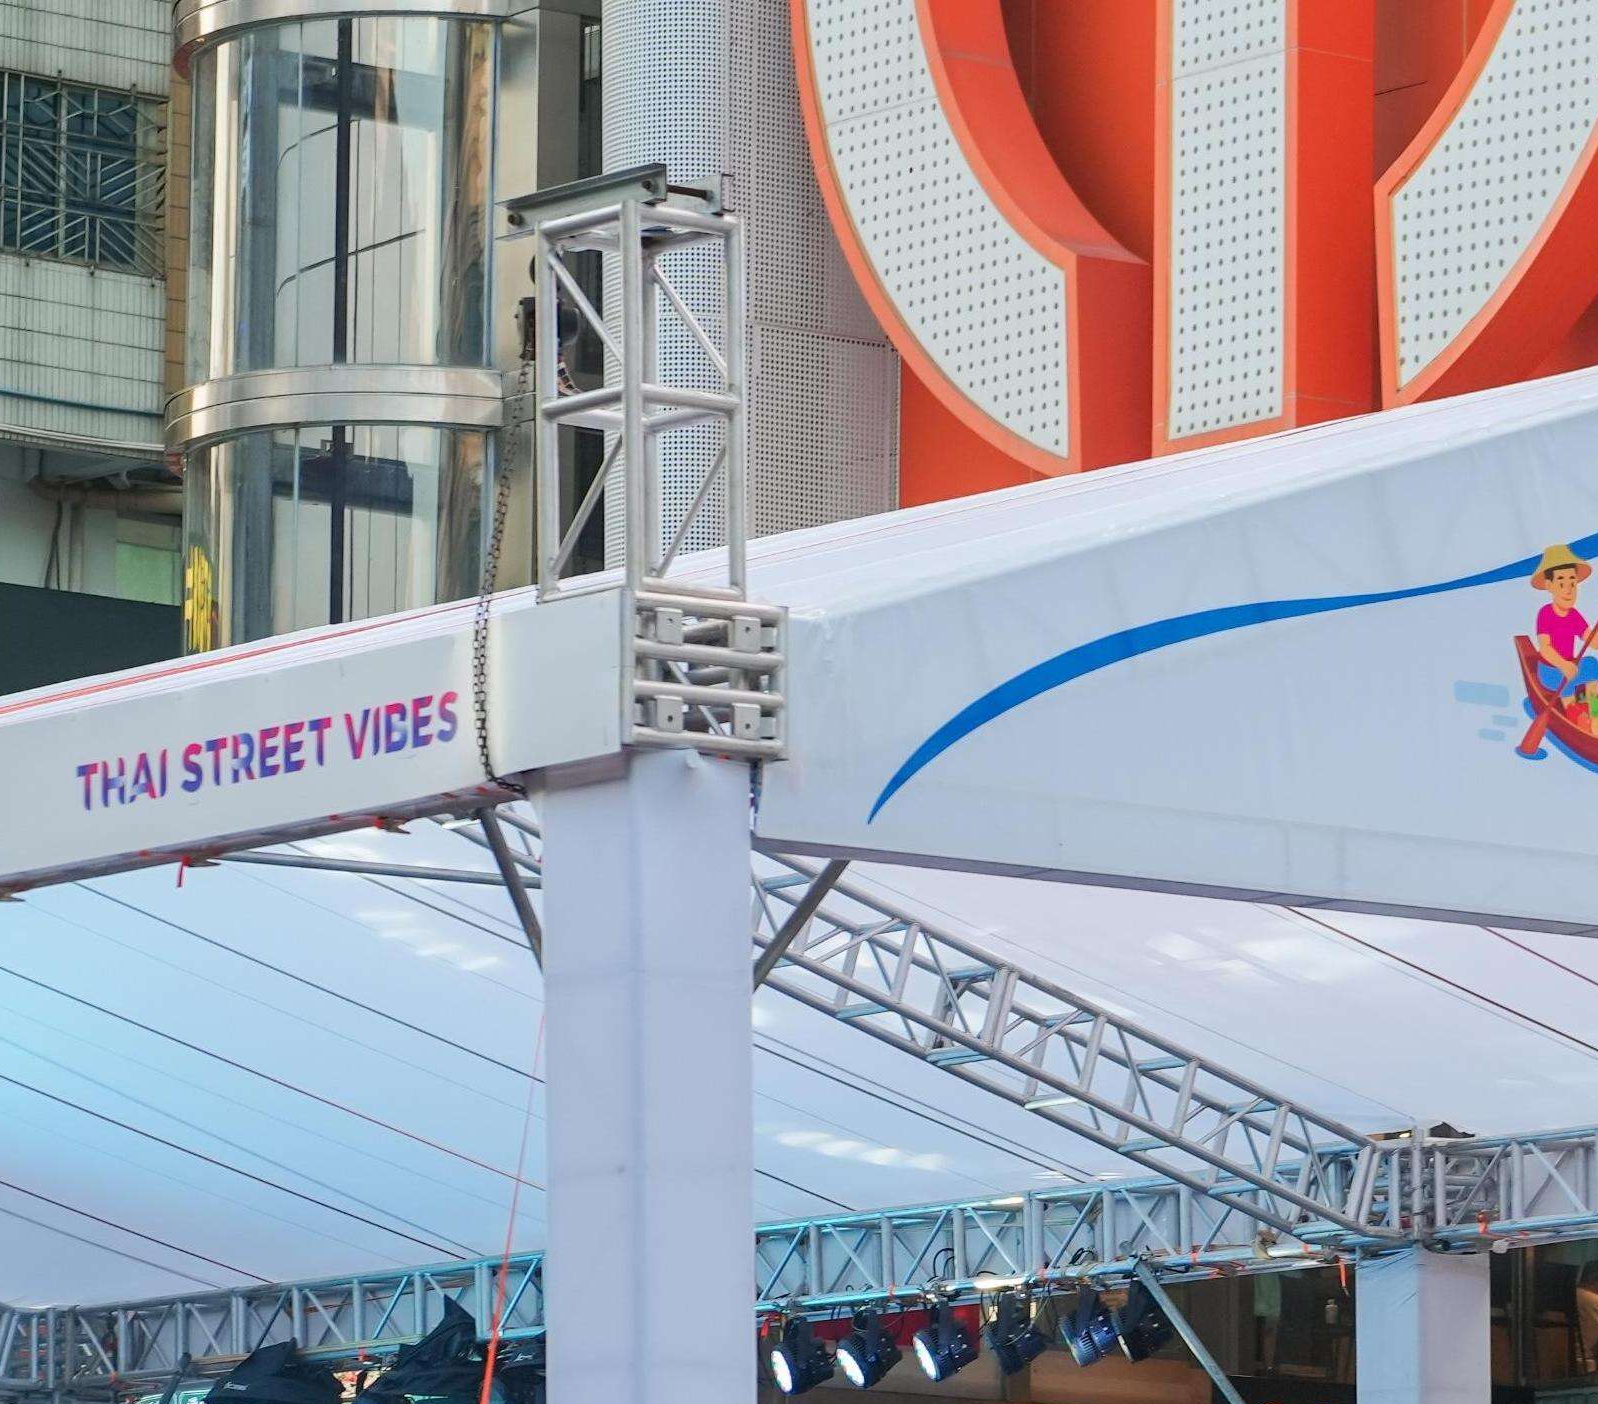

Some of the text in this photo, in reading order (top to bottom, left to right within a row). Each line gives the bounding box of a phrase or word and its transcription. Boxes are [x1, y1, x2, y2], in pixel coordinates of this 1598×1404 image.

[76, 690, 459, 811] THAI STREET VIBES
